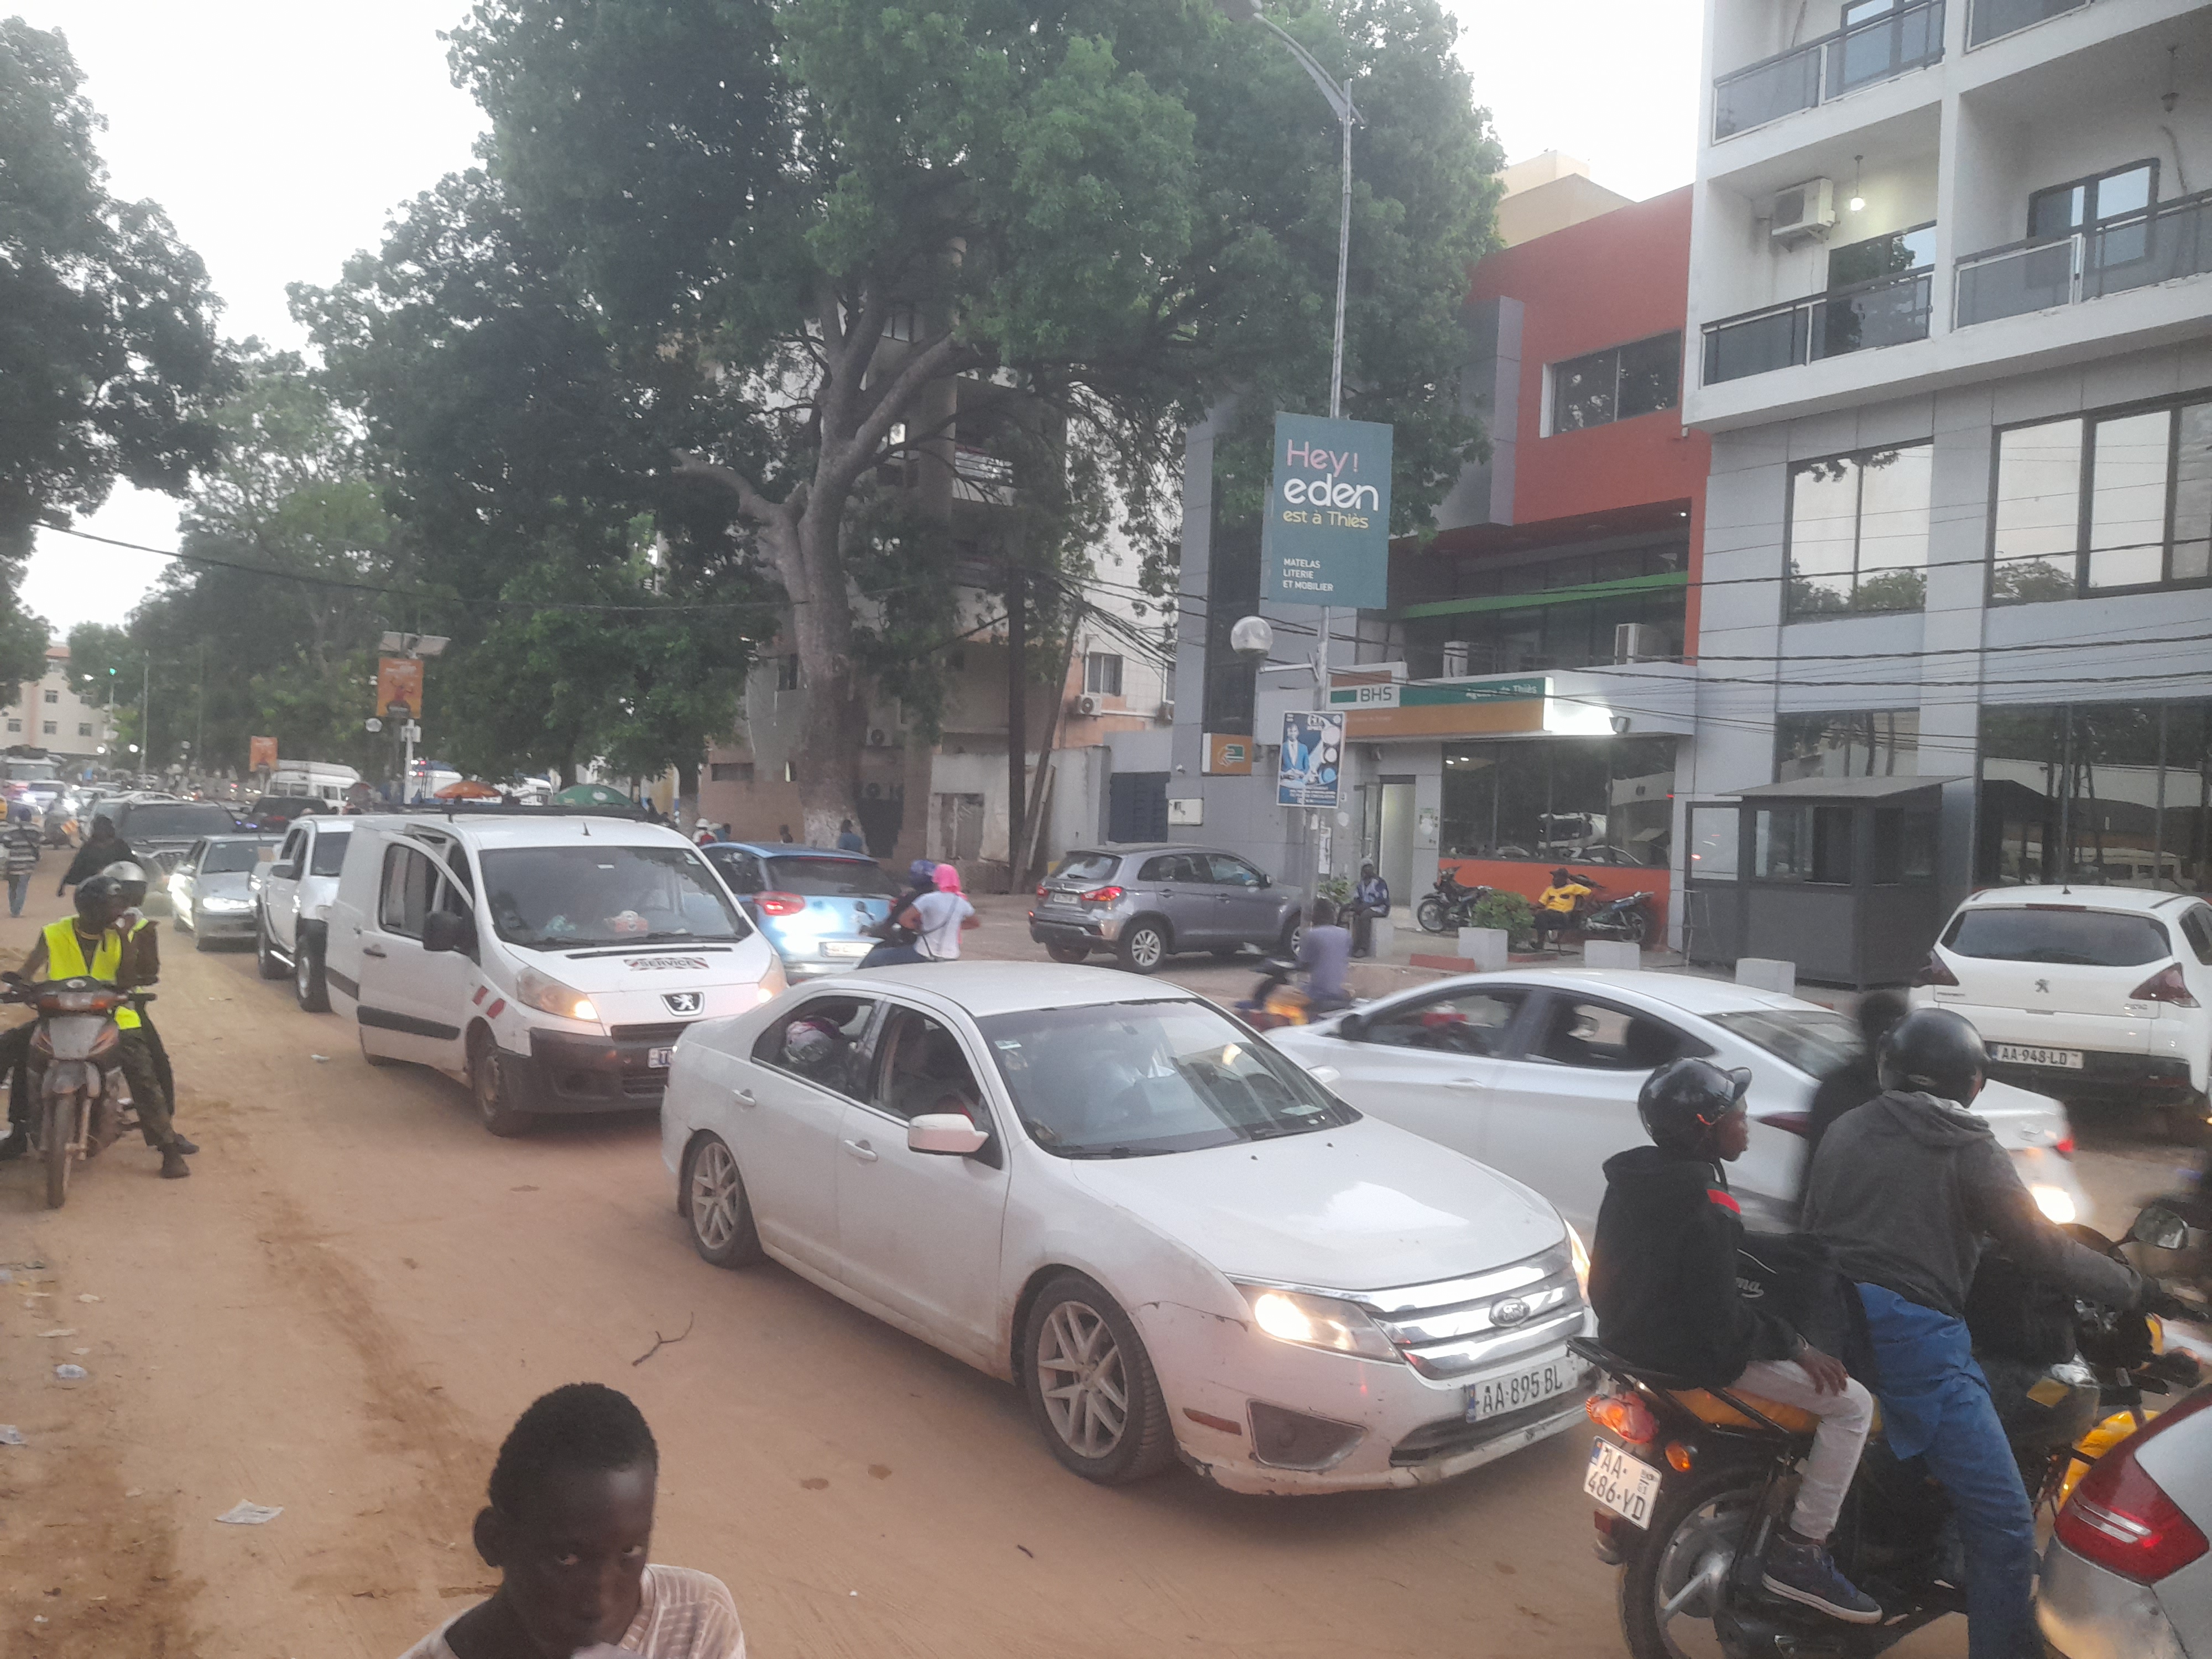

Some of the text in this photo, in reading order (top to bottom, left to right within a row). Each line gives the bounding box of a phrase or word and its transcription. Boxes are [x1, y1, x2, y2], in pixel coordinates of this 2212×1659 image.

[1284, 473, 1379, 511] eden
[1282, 509, 1369, 529] est à Thiès
[1284, 558, 1321, 568] MATELAS
[1283, 568, 1314, 579] LITERIE
[1283, 580, 1333, 591] ET MOBILIER
[1361, 687, 1392, 702] BHS
